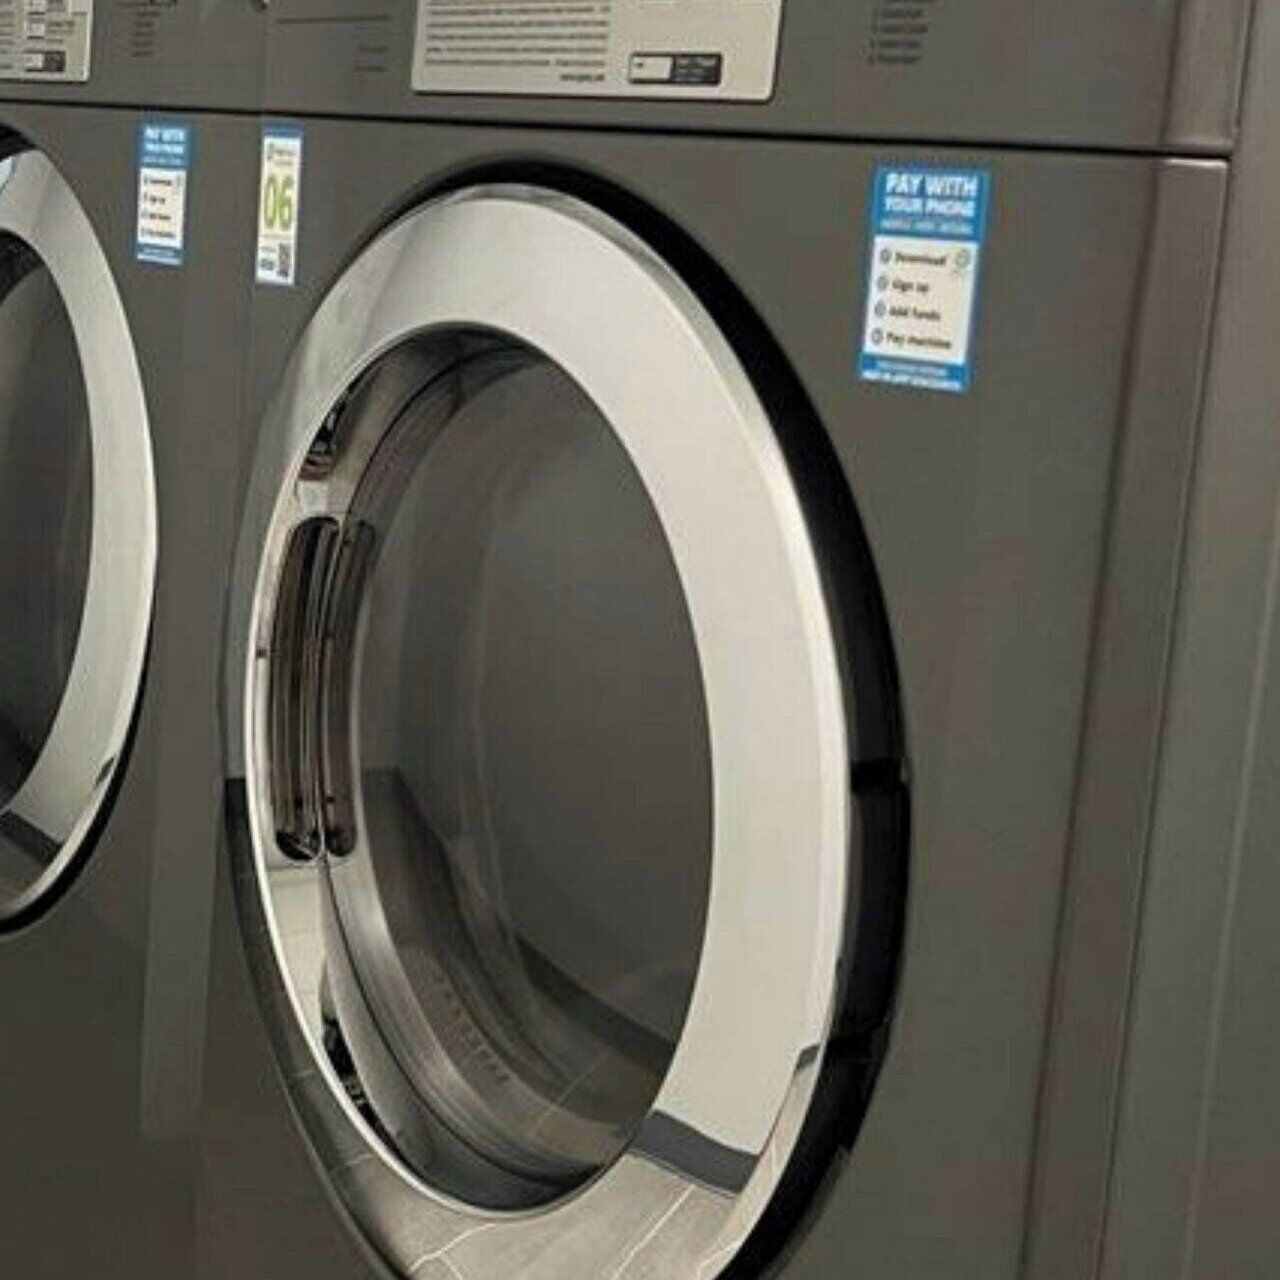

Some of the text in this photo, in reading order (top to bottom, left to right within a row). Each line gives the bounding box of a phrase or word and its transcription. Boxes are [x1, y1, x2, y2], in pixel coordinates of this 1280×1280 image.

[885, 173, 978, 198] PAY WITH
[264, 174, 294, 232] 06
[884, 196, 976, 218] YOUR PHONE
